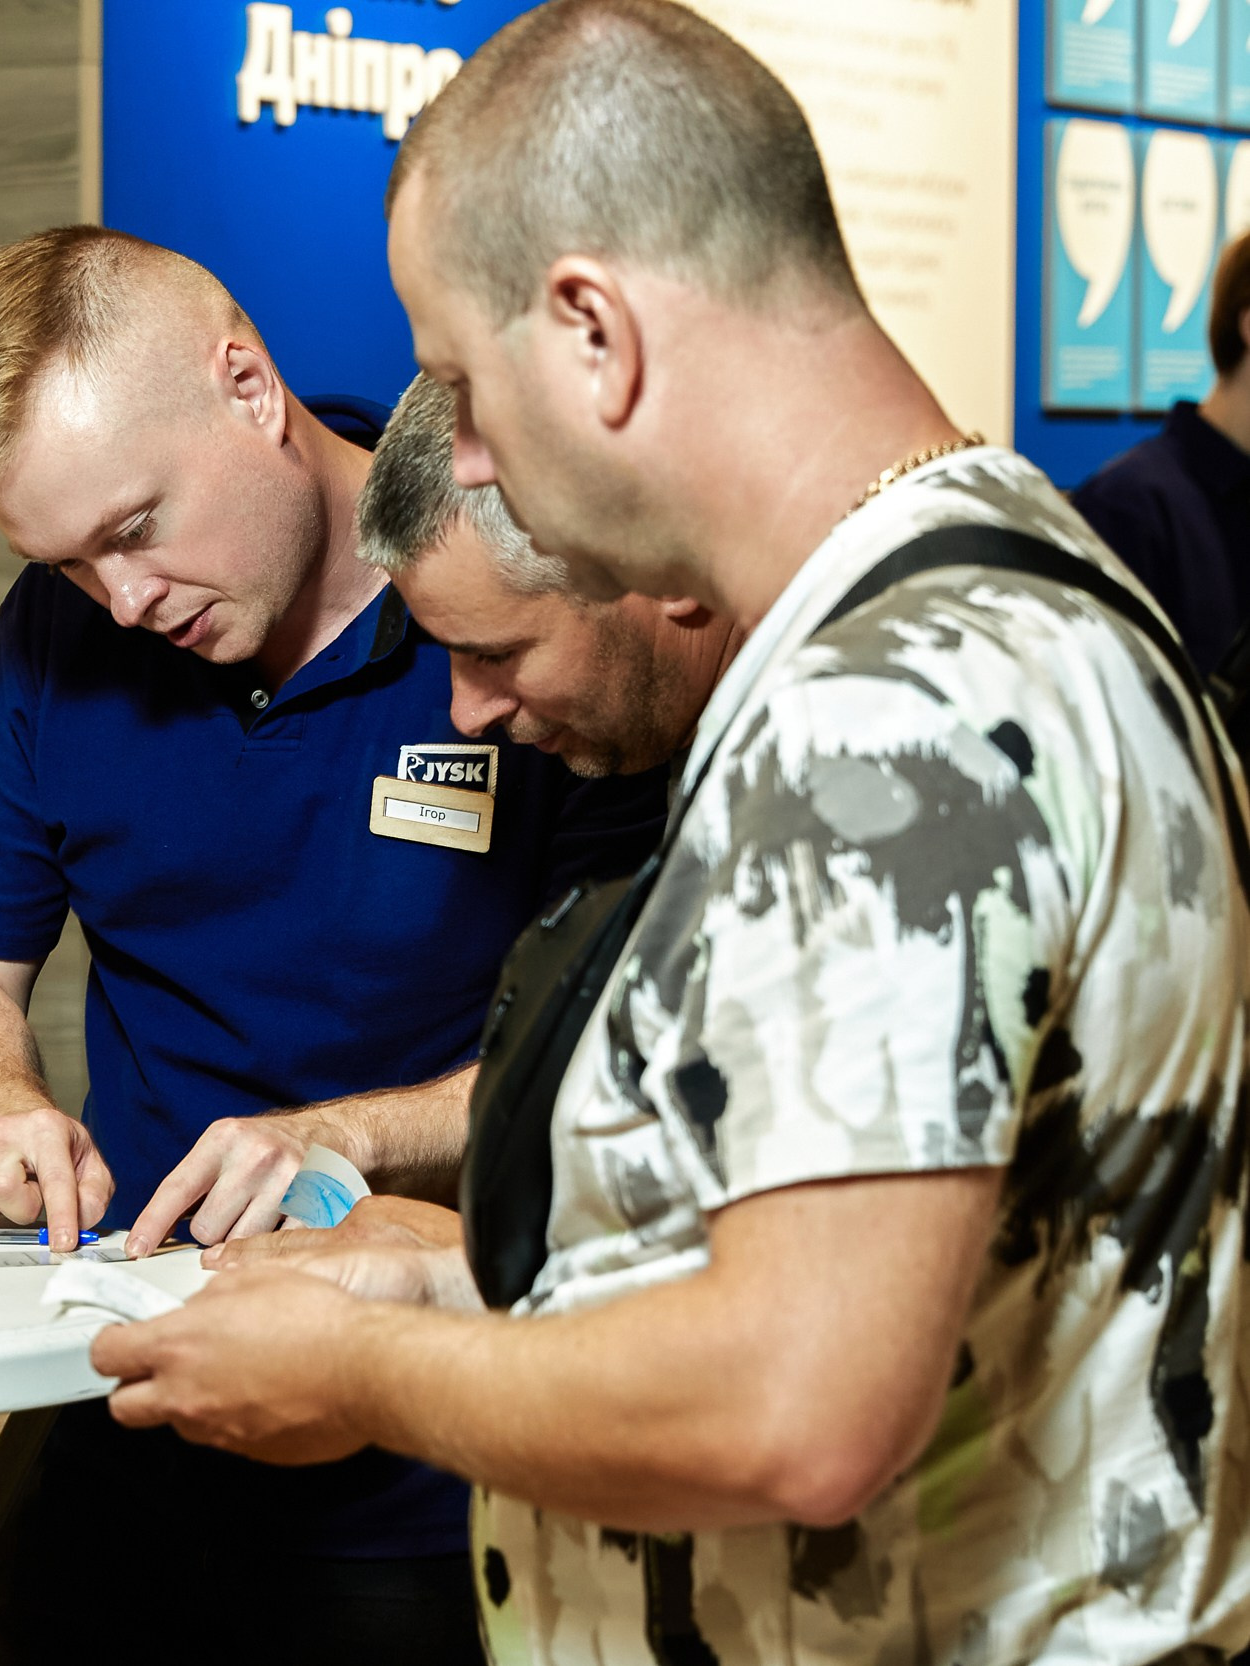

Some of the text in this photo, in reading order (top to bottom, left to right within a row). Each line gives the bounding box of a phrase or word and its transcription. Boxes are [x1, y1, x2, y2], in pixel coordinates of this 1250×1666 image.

[236, 2, 463, 141] Дніпро
[422, 761, 485, 783] JYSK
[419, 806, 446, 822] Ігор
